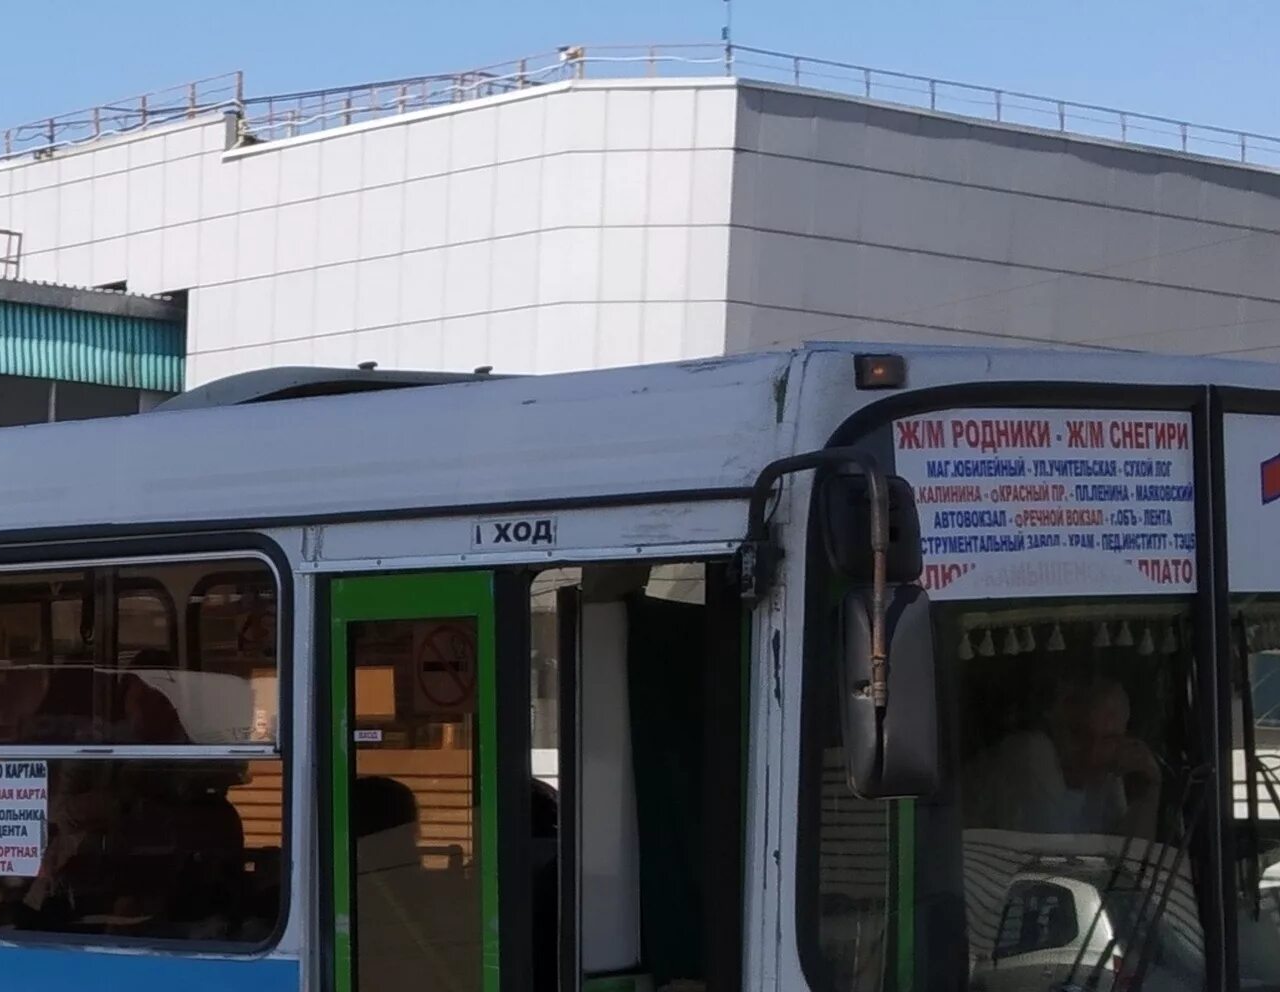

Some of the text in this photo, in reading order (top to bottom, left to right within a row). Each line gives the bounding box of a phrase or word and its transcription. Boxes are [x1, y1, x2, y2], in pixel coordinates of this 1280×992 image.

[897, 419, 1189, 454] Ж/М РОДНИКИ Ж/М СНЕГИРИ
[1123, 457, 1153, 478] СУХОЙ
[913, 485, 983, 504] .КАЛИНИНА
[934, 509, 1007, 529] АВТОВОКЗАЛ
[1066, 508, 1104, 527] ВОКЗАЛ
[1143, 508, 1173, 527] ЛЕНТА
[16, 788, 47, 800] КАРТА
